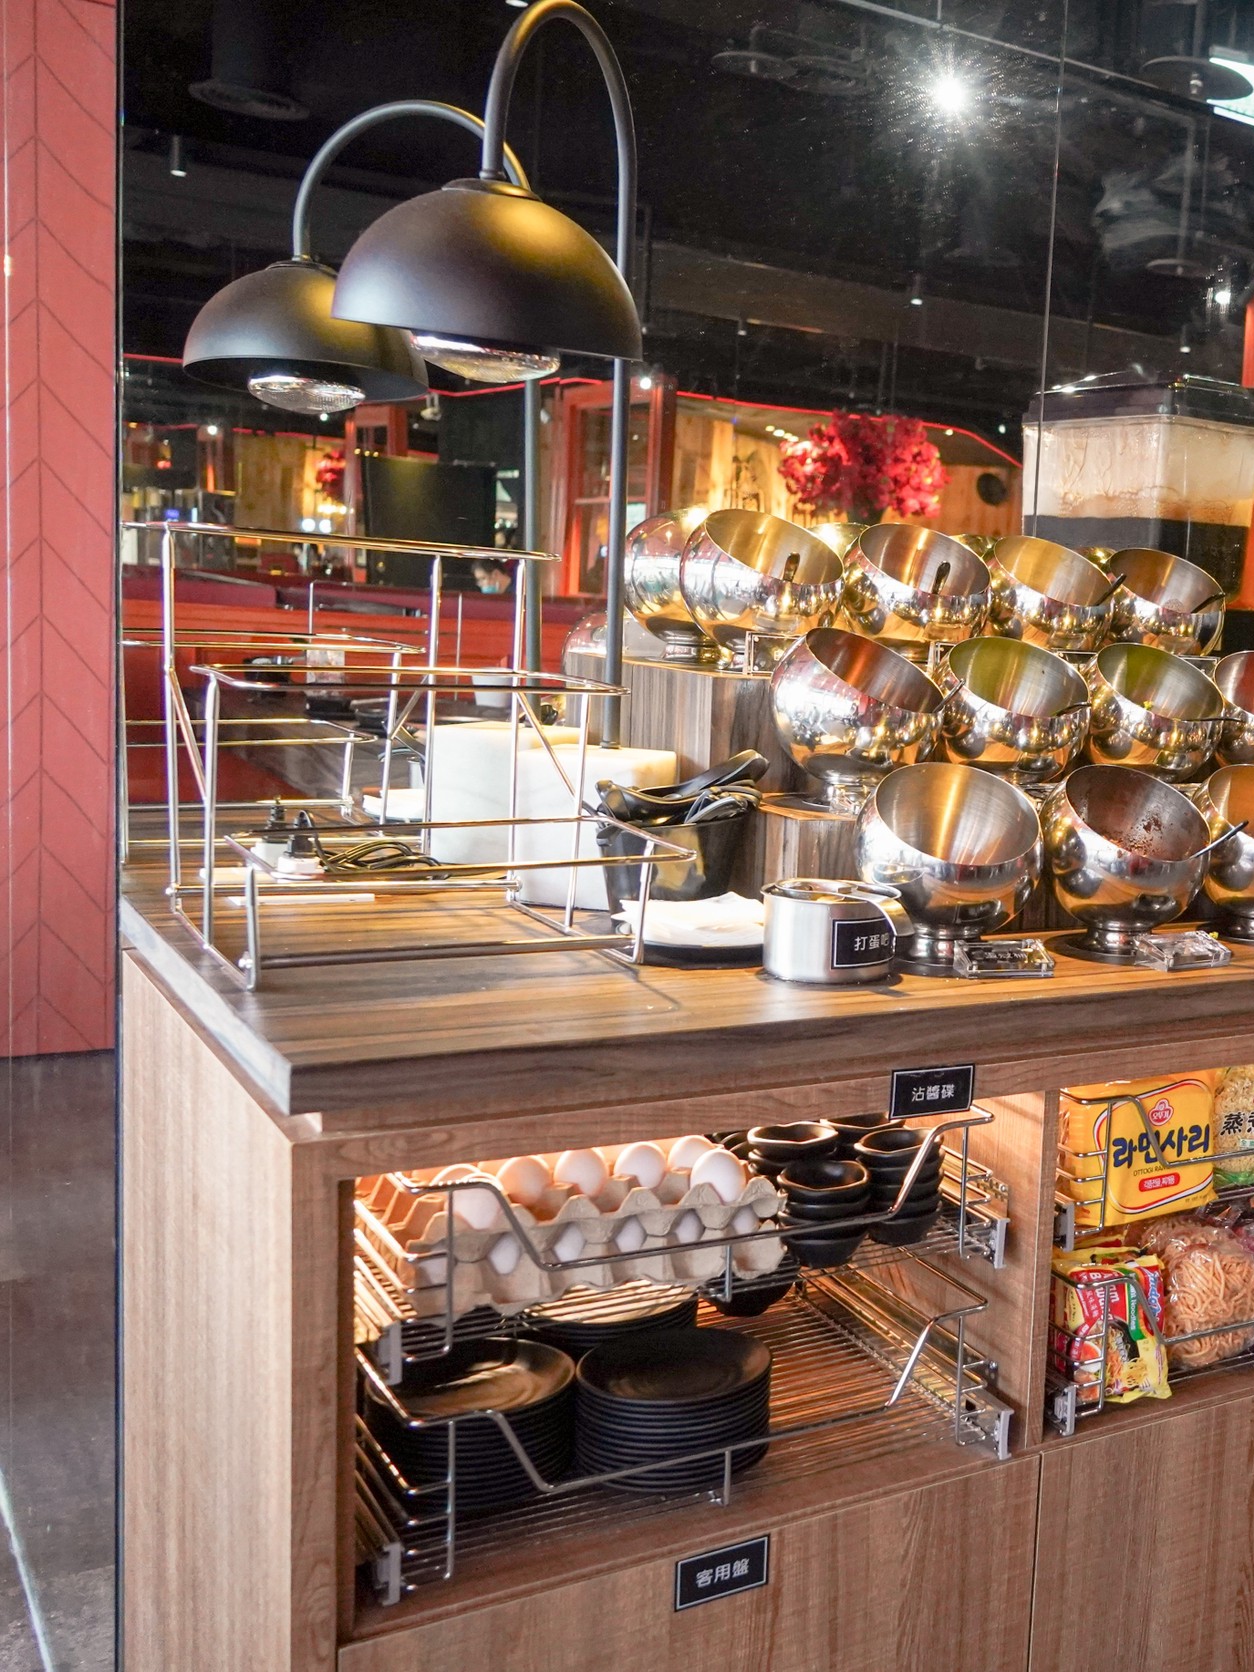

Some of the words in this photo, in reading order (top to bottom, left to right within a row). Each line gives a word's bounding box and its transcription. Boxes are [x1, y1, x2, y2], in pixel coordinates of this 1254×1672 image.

[911, 1083, 955, 1102] 沾醬碟
[1112, 1123, 1210, 1169] 라면사리
[695, 1558, 750, 1588] 客用盤
